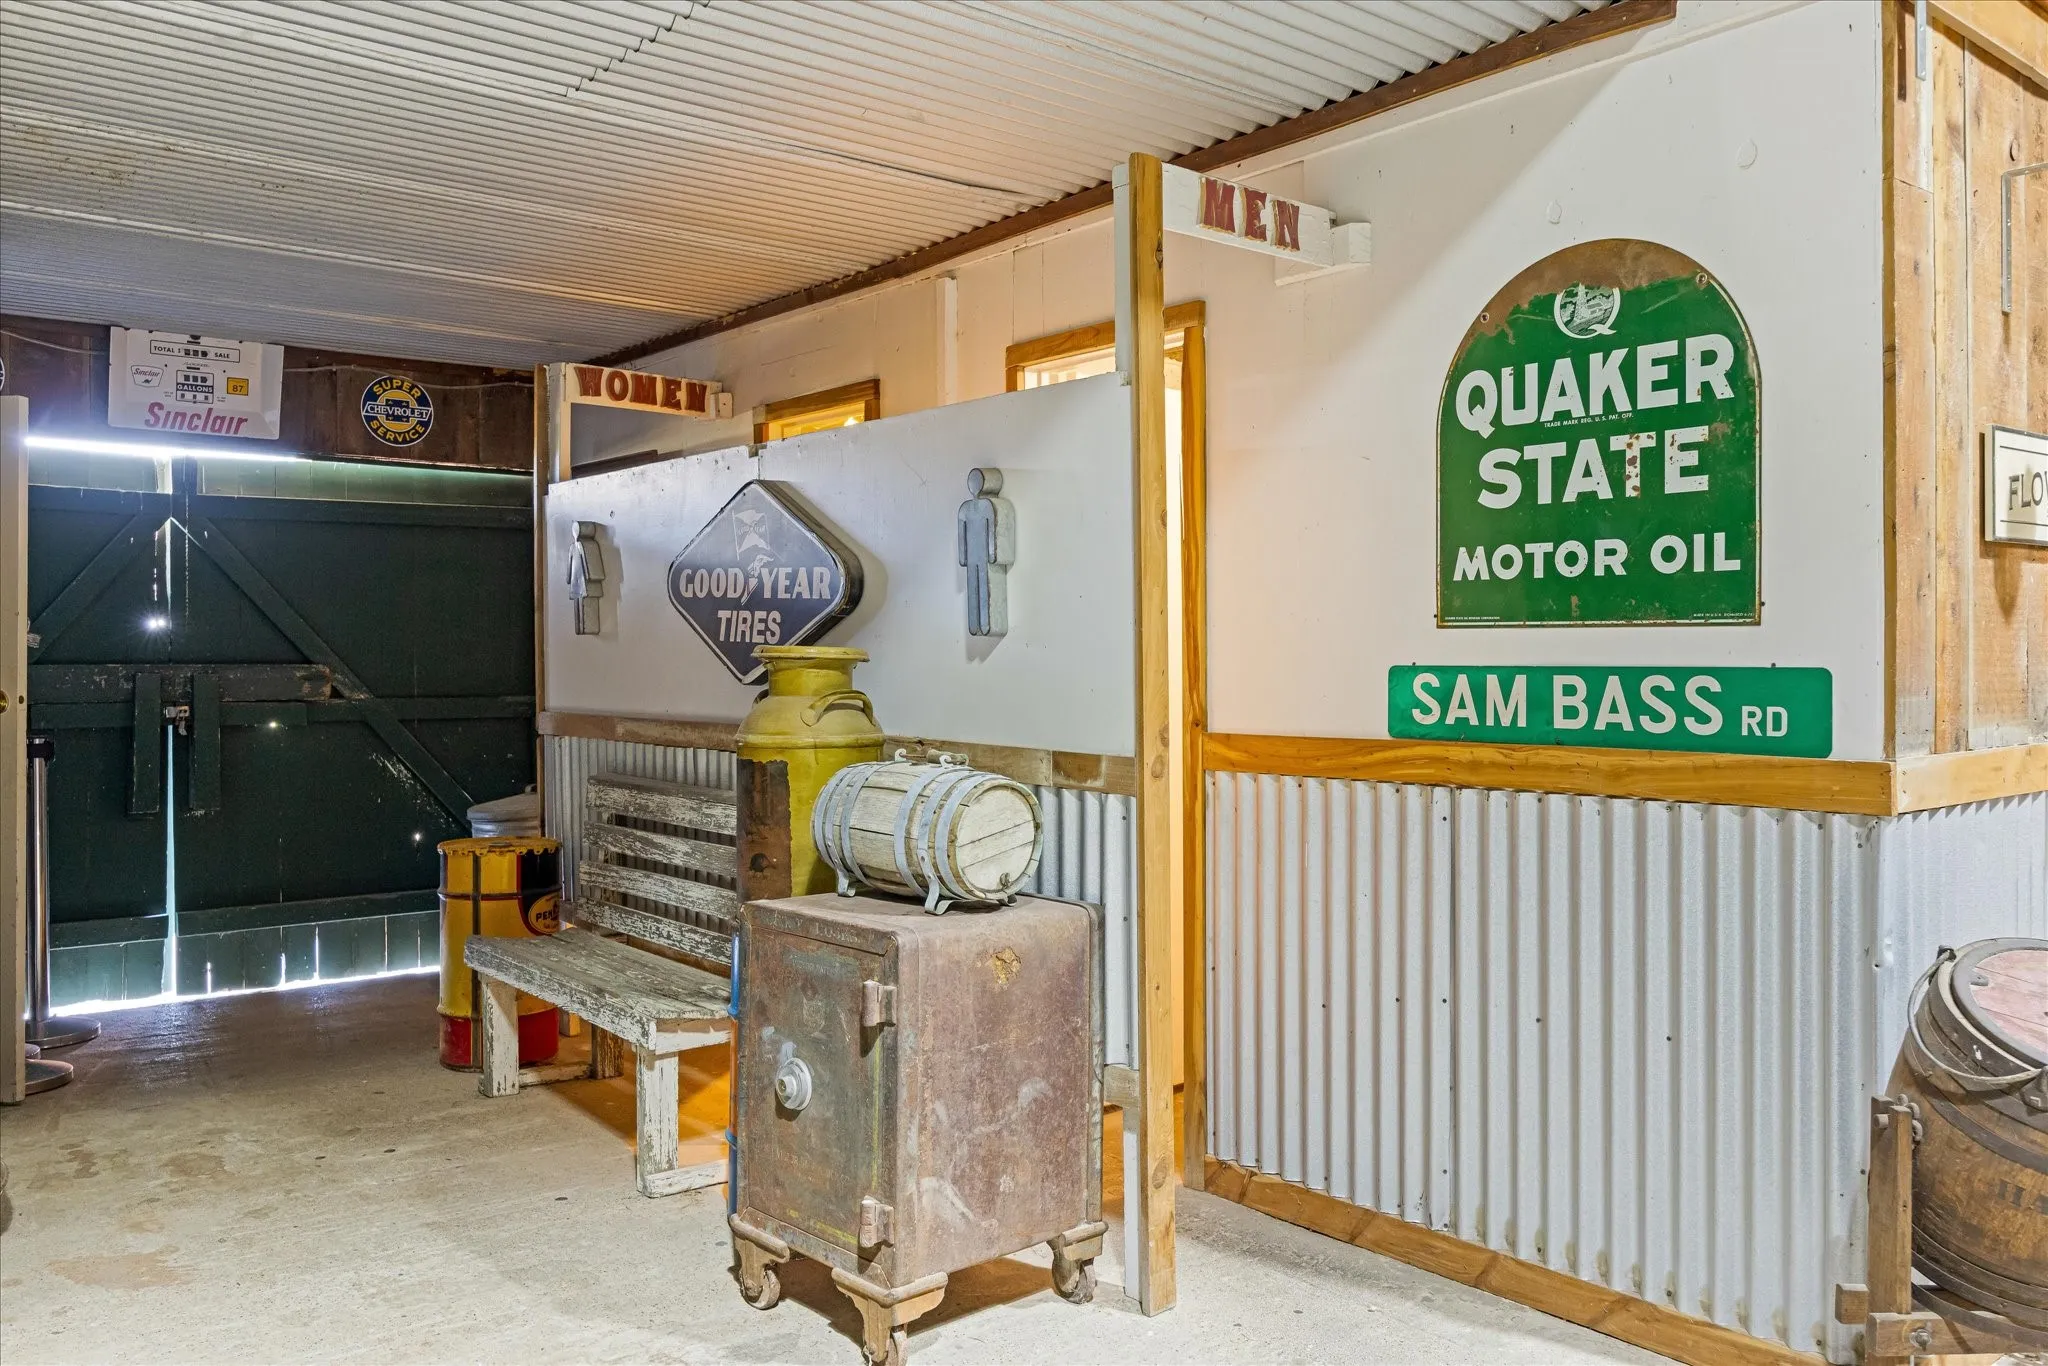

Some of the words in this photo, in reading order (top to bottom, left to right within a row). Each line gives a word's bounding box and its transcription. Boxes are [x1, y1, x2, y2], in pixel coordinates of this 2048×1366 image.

[1199, 176, 1300, 251] MEN
[153, 345, 175, 353] TOTAL
[132, 368, 161, 378] Sinclair
[177, 384, 213, 393] GALLONS
[232, 384, 244, 393] 87
[373, 379, 422, 399] SUPER
[574, 367, 707, 412] WOMEN
[1454, 333, 1735, 439] QUAKER
[144, 402, 248, 435] Sinclair
[367, 405, 428, 418] CHEVROLET
[370, 420, 425, 443] SERVICE
[1477, 426, 1710, 510] STATE
[2008, 470, 2048, 511] FLO
[1453, 538, 1628, 582] MOTOR
[1650, 531, 1741, 575] OIL
[717, 610, 781, 645] TIRES
[1412, 673, 1527, 727] SAM
[1552, 675, 1723, 735] BASS
[1741, 705, 1788, 737] RD
